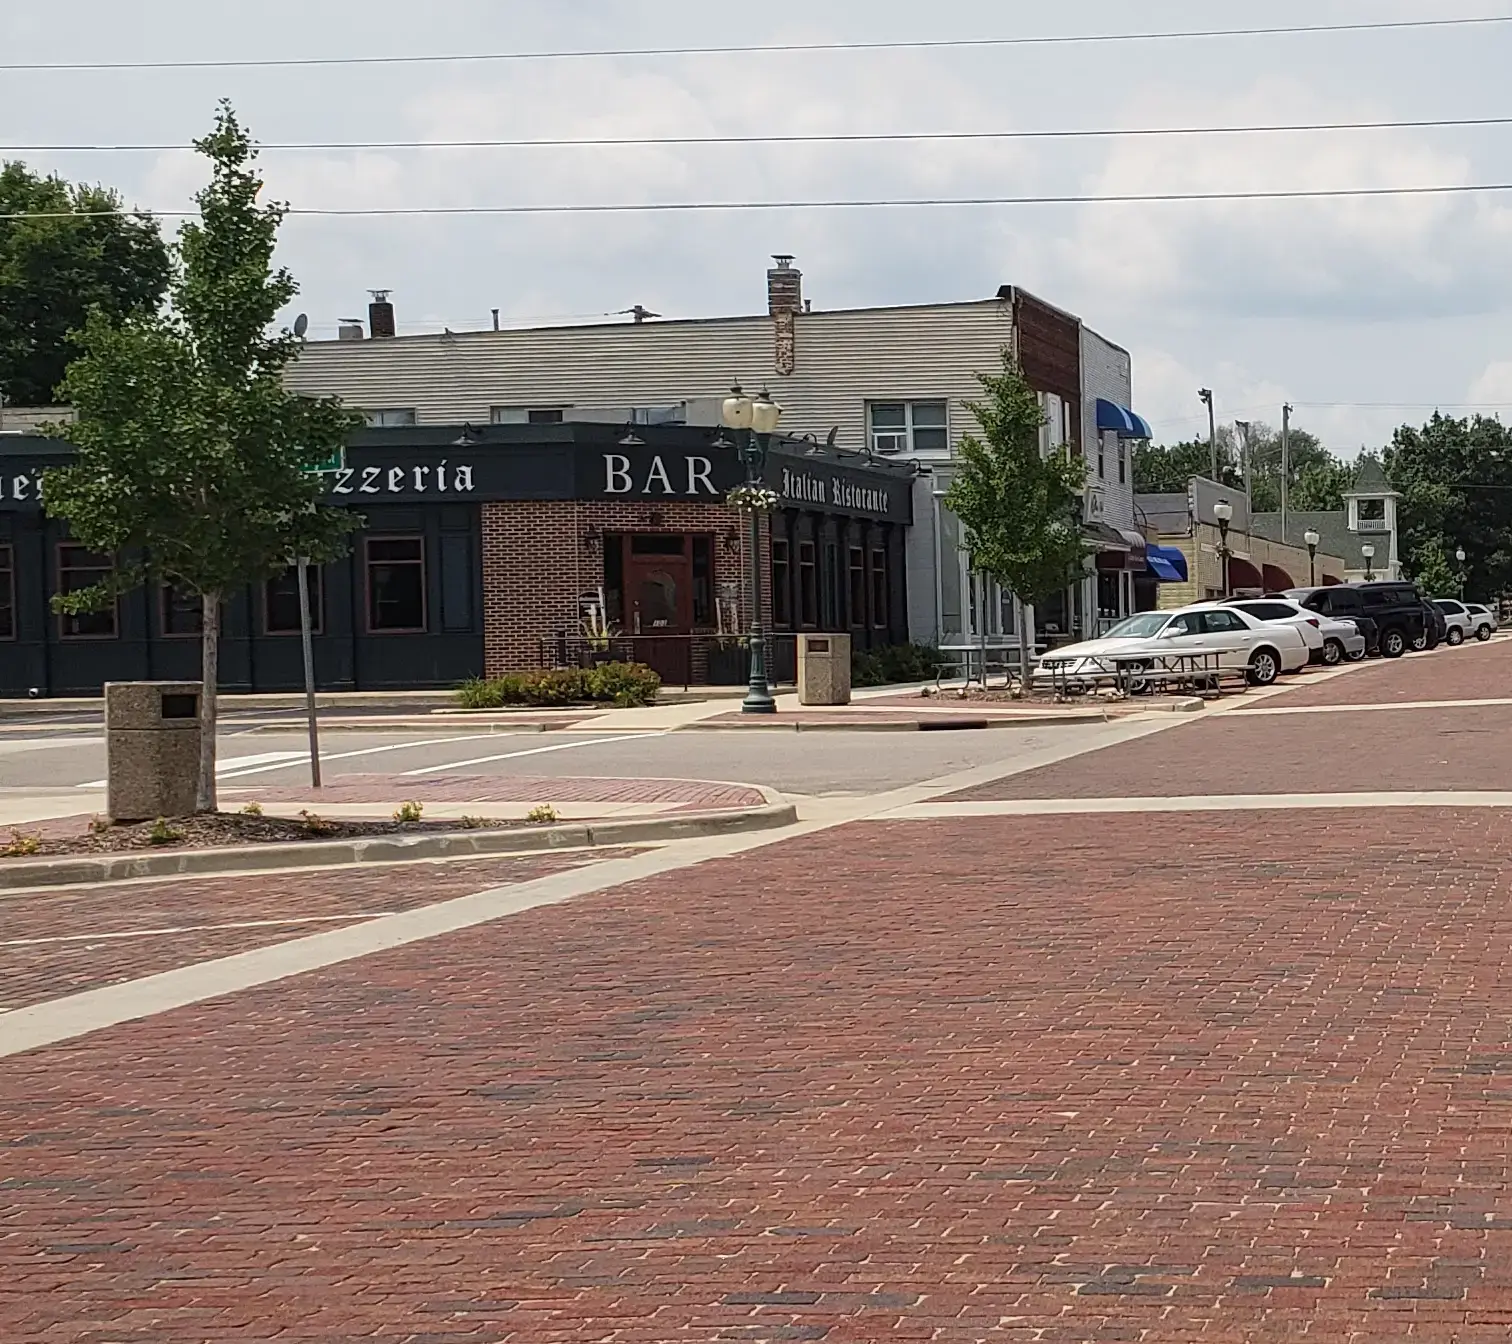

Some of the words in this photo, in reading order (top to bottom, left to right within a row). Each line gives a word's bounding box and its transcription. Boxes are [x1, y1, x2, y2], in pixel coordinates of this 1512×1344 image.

[332, 459, 475, 494] zzeria
[602, 454, 719, 494] BAR
[782, 467, 826, 503] Italian
[831, 477, 889, 513] Ristorante
